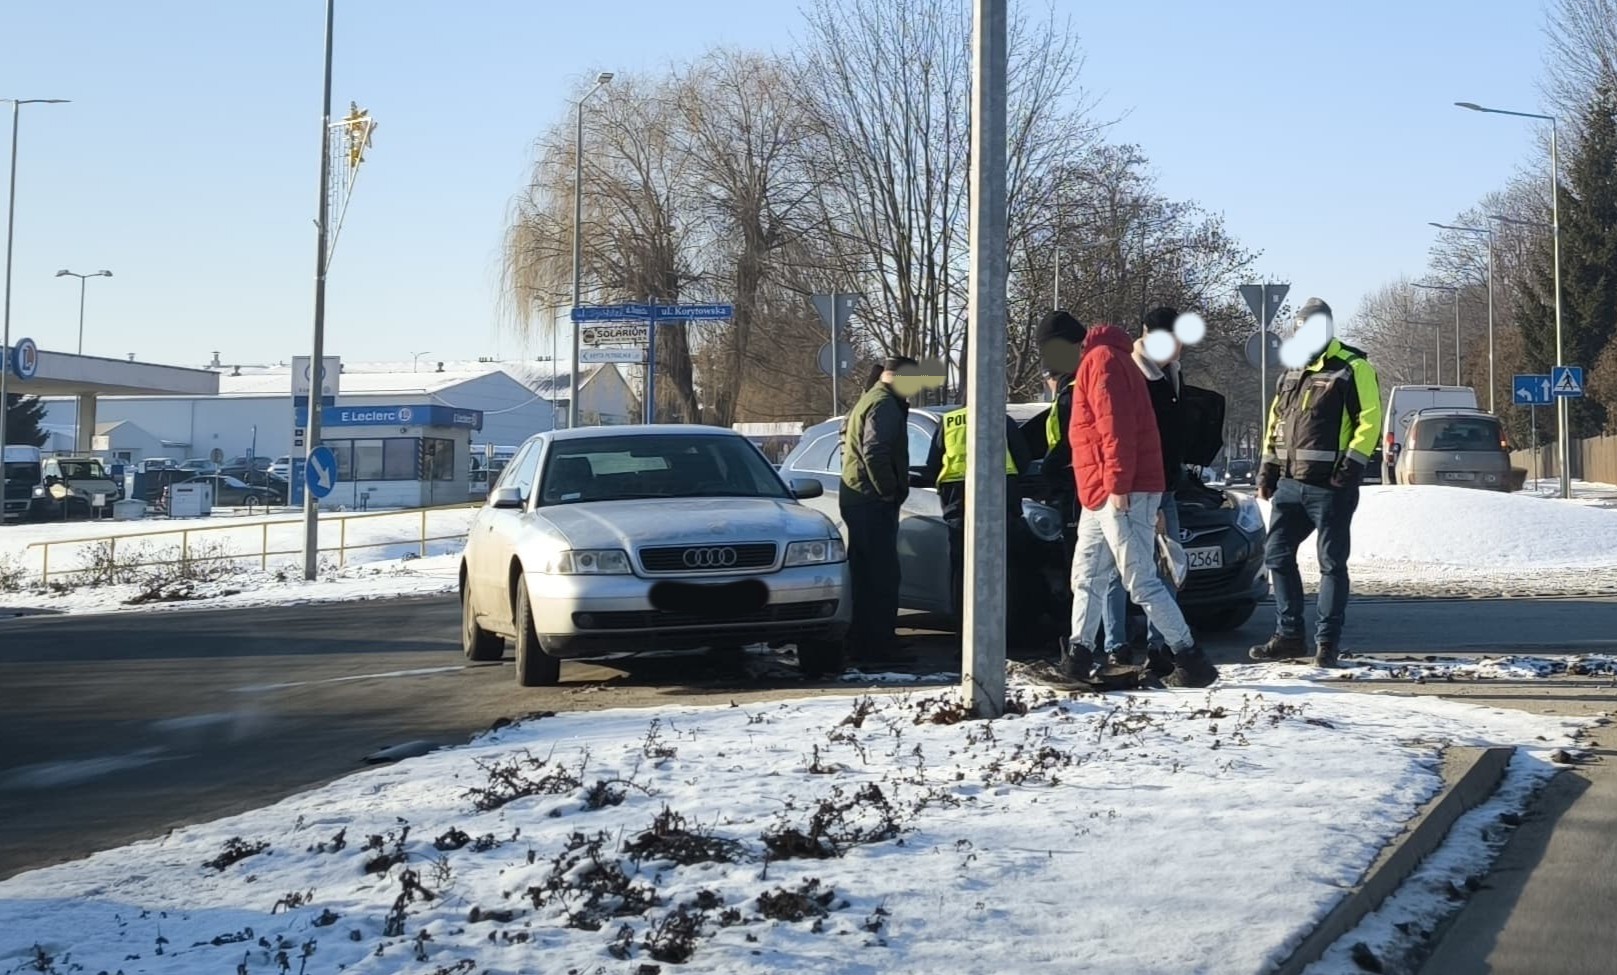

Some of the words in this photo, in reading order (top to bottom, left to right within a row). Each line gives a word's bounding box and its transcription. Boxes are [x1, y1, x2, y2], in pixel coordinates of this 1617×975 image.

[661, 307, 673, 316] ul.
[674, 306, 726, 318] Korytowska
[596, 328, 647, 338] SOLARIUM
[1185, 551, 1220, 568] 2564
